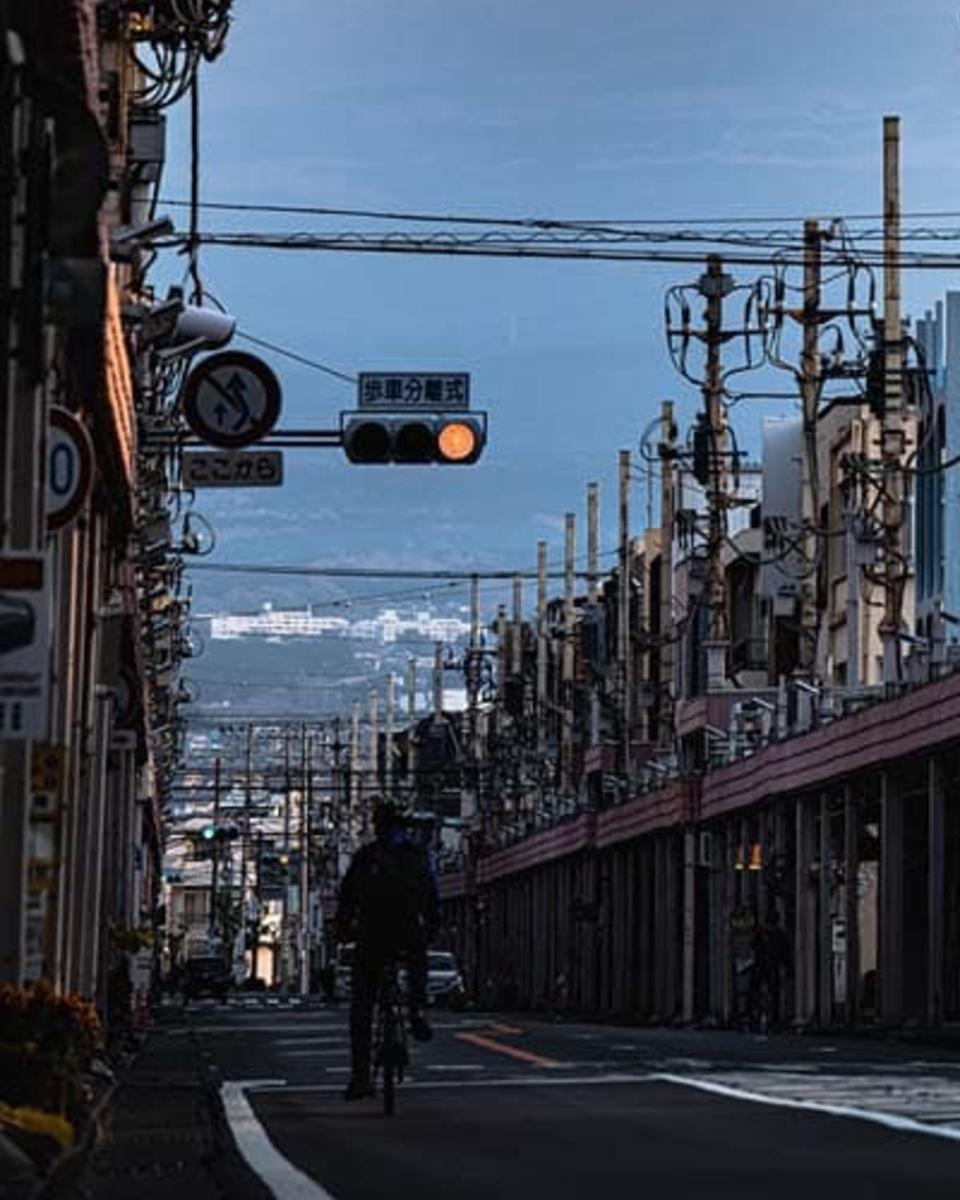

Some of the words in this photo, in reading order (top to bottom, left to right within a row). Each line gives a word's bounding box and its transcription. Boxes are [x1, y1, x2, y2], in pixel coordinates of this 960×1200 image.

[364, 378, 463, 402] 歩車分離式
[50, 442, 74, 495] 0
[191, 457, 275, 480] ここから
